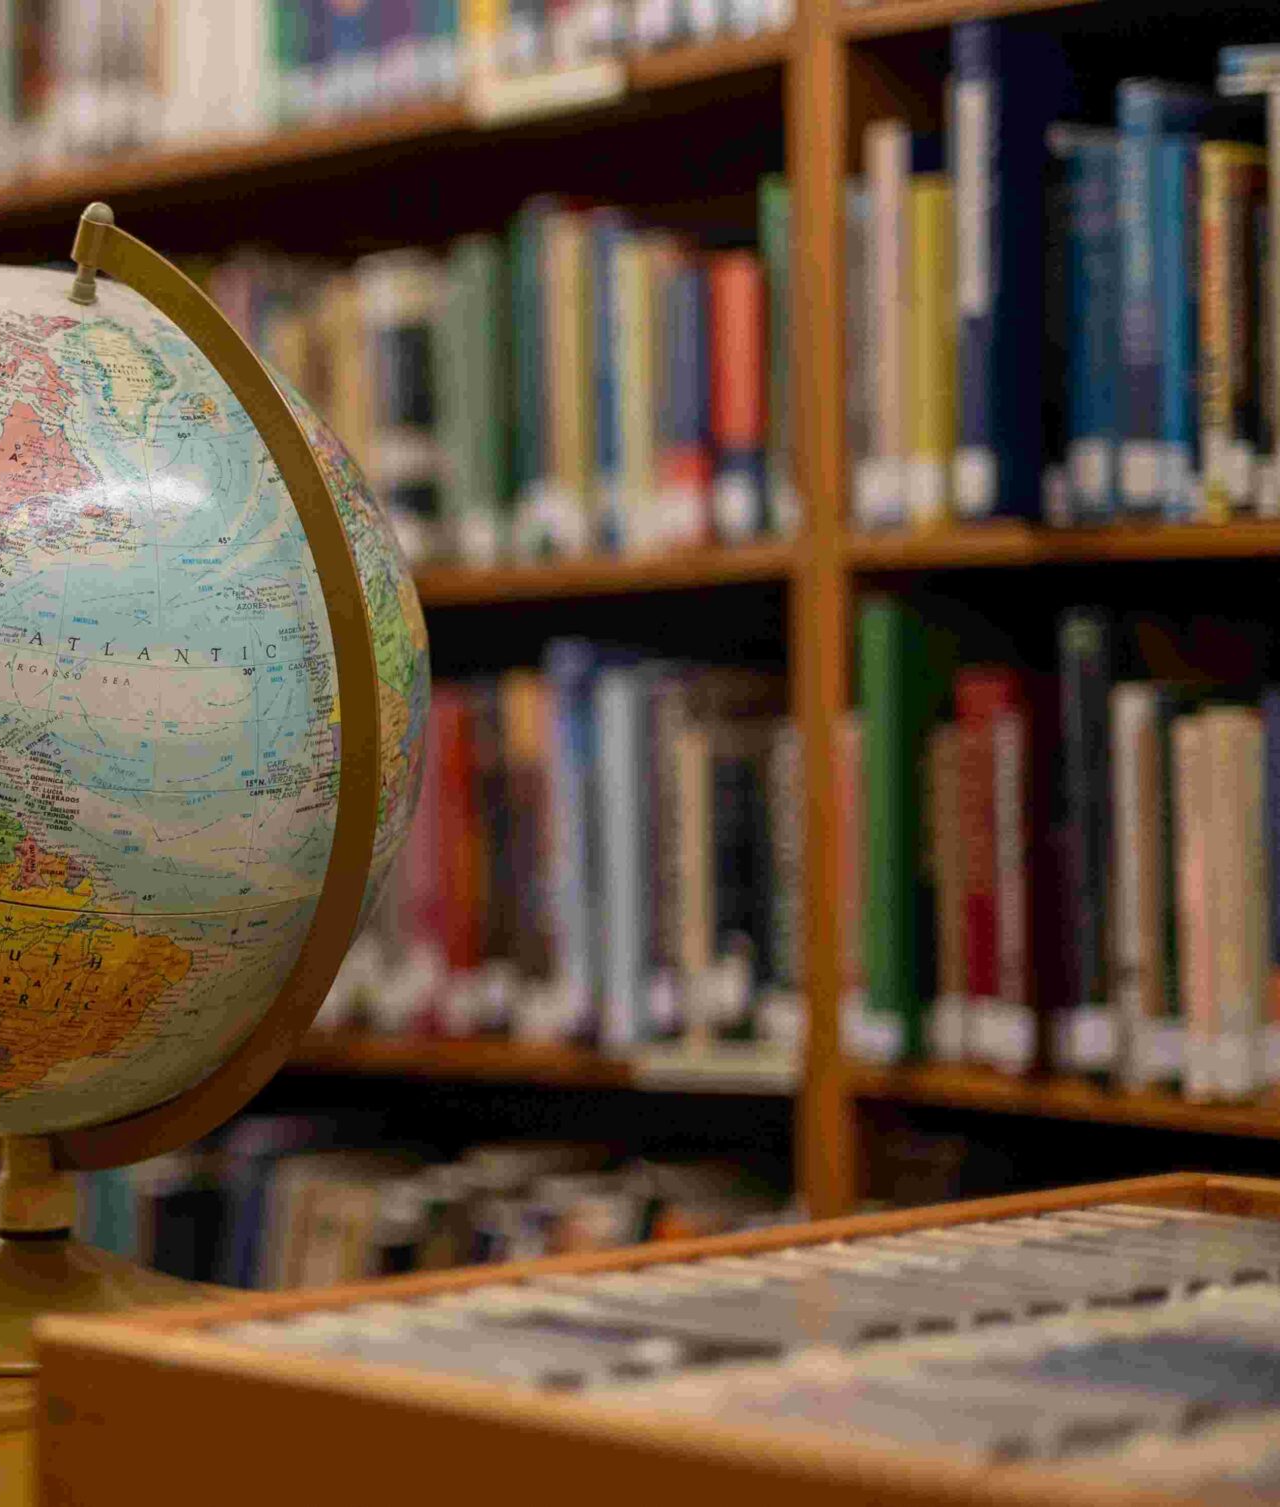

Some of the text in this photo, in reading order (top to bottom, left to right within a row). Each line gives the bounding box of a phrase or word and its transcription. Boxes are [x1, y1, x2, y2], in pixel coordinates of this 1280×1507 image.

[218, 536, 231, 544] 45°
[0, 564, 13, 577] York
[236, 602, 268, 610] AZORES
[28, 631, 277, 664] ATLANTIC
[242, 666, 256, 676] 30°
[102, 675, 130, 687] SEA
[30, 774, 64, 784] DOMINICA
[42, 787, 63, 796] LUCIA
[41, 793, 80, 804] BARBADOS
[53, 818, 69, 826] AND
[46, 823, 73, 832] TOBAGO
